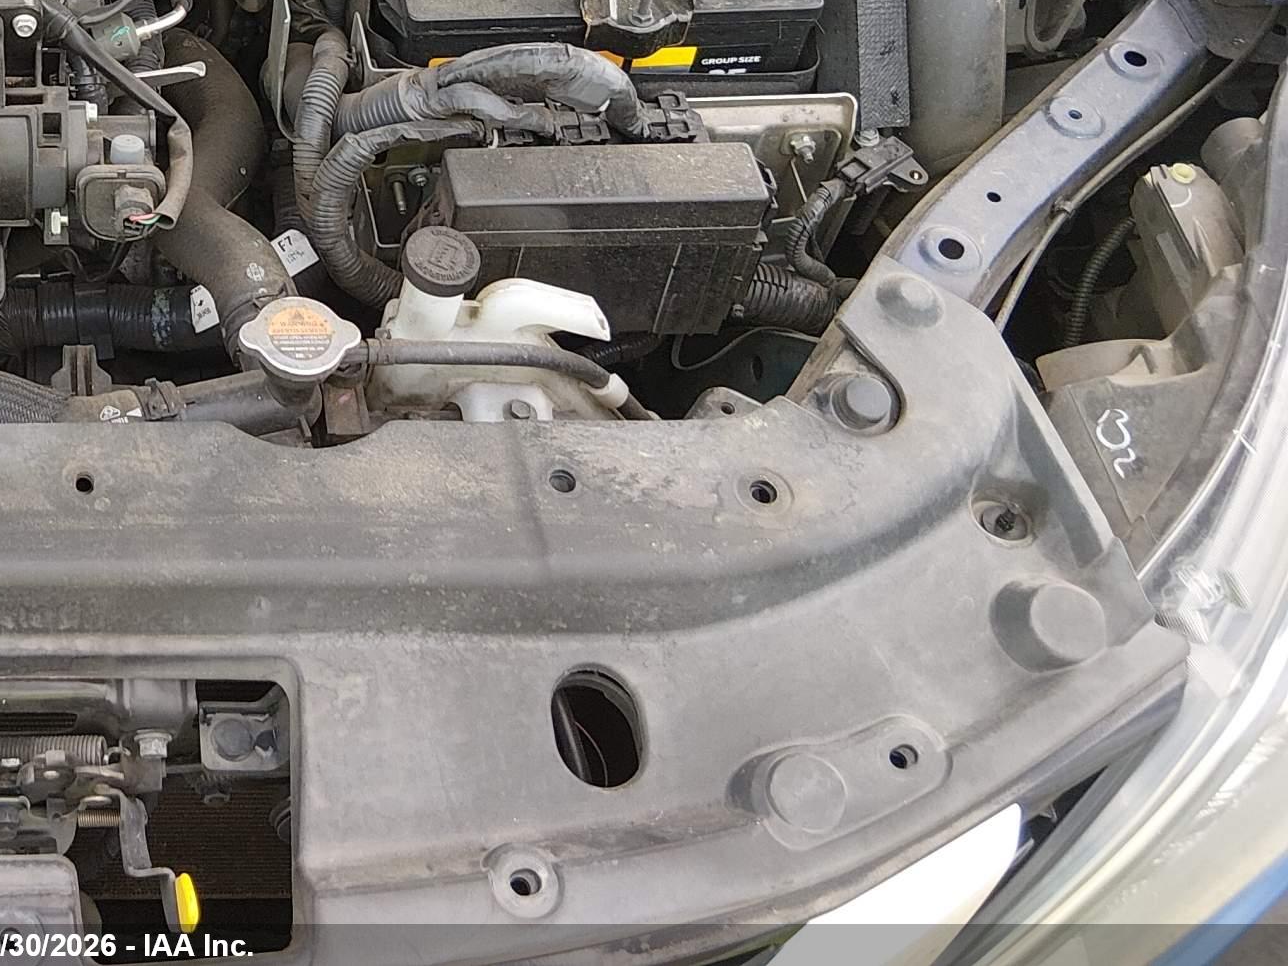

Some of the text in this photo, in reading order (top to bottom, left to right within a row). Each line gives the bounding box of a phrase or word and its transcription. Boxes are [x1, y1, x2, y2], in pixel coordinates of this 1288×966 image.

[701, 55, 761, 65] GROUP SIZE
[277, 235, 293, 252] F7
